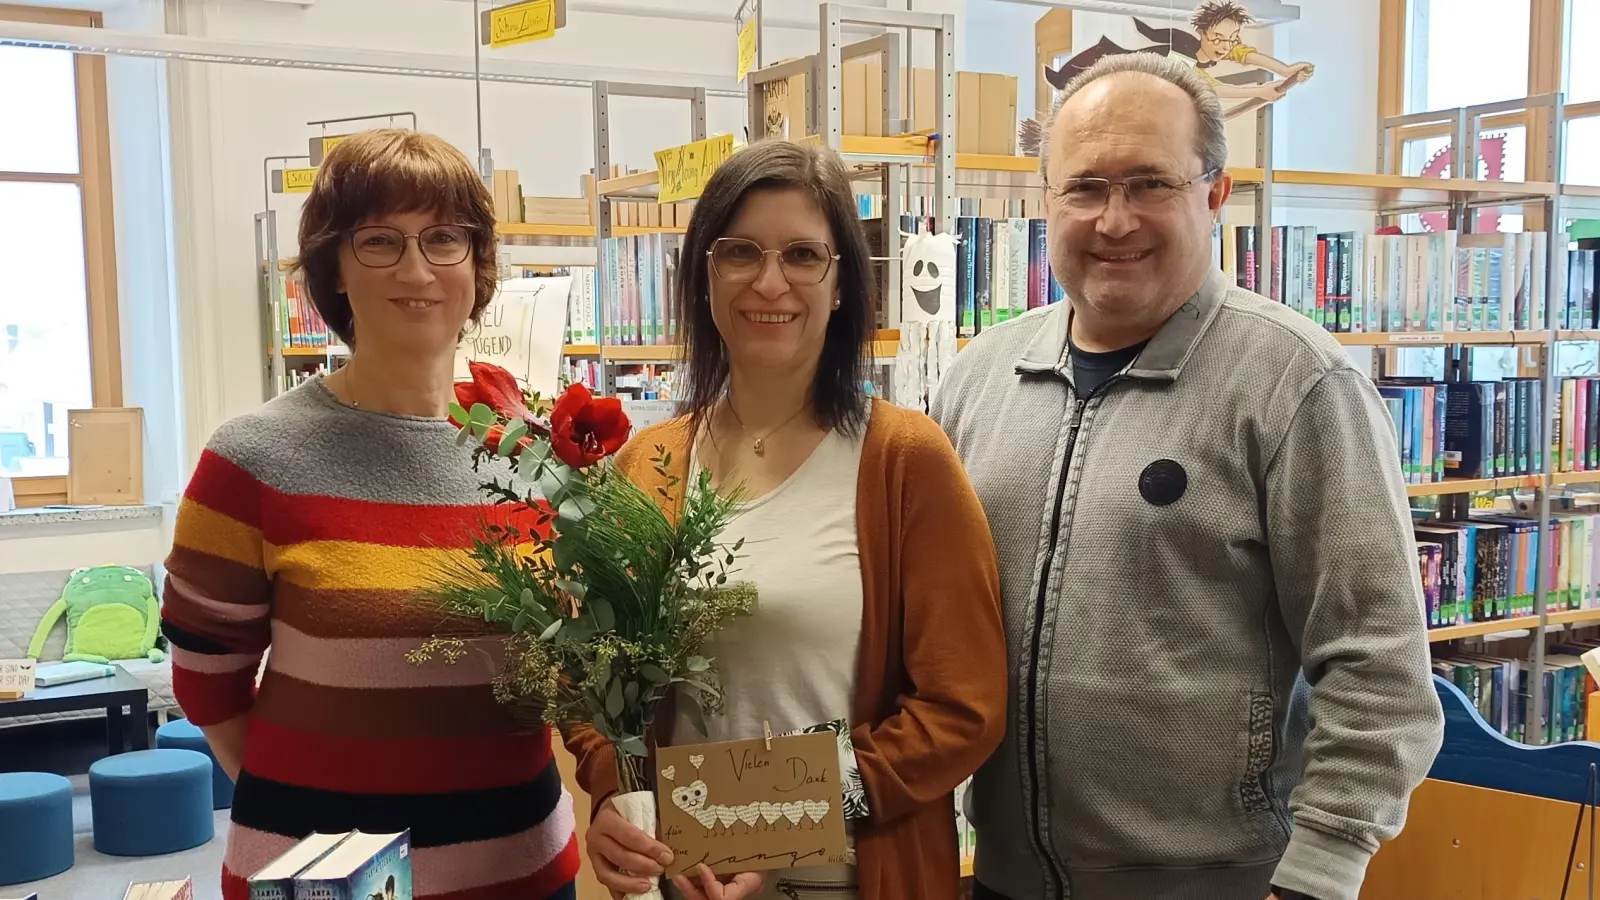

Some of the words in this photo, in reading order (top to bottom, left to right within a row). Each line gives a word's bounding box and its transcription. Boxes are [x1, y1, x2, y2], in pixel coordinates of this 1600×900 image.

[1010, 248, 1020, 310] VERTRAUEN
[1326, 252, 1335, 295] BODYGUARD
[1340, 253, 1349, 295] BODYGUARD
[484, 304, 504, 328] EU
[5, 664, 19, 673] SIND
[726, 748, 770, 782] Vielen
[773, 757, 828, 792] Dank
[665, 825, 683, 840] für
[670, 846, 689, 857] eine
[680, 847, 826, 873] lange
